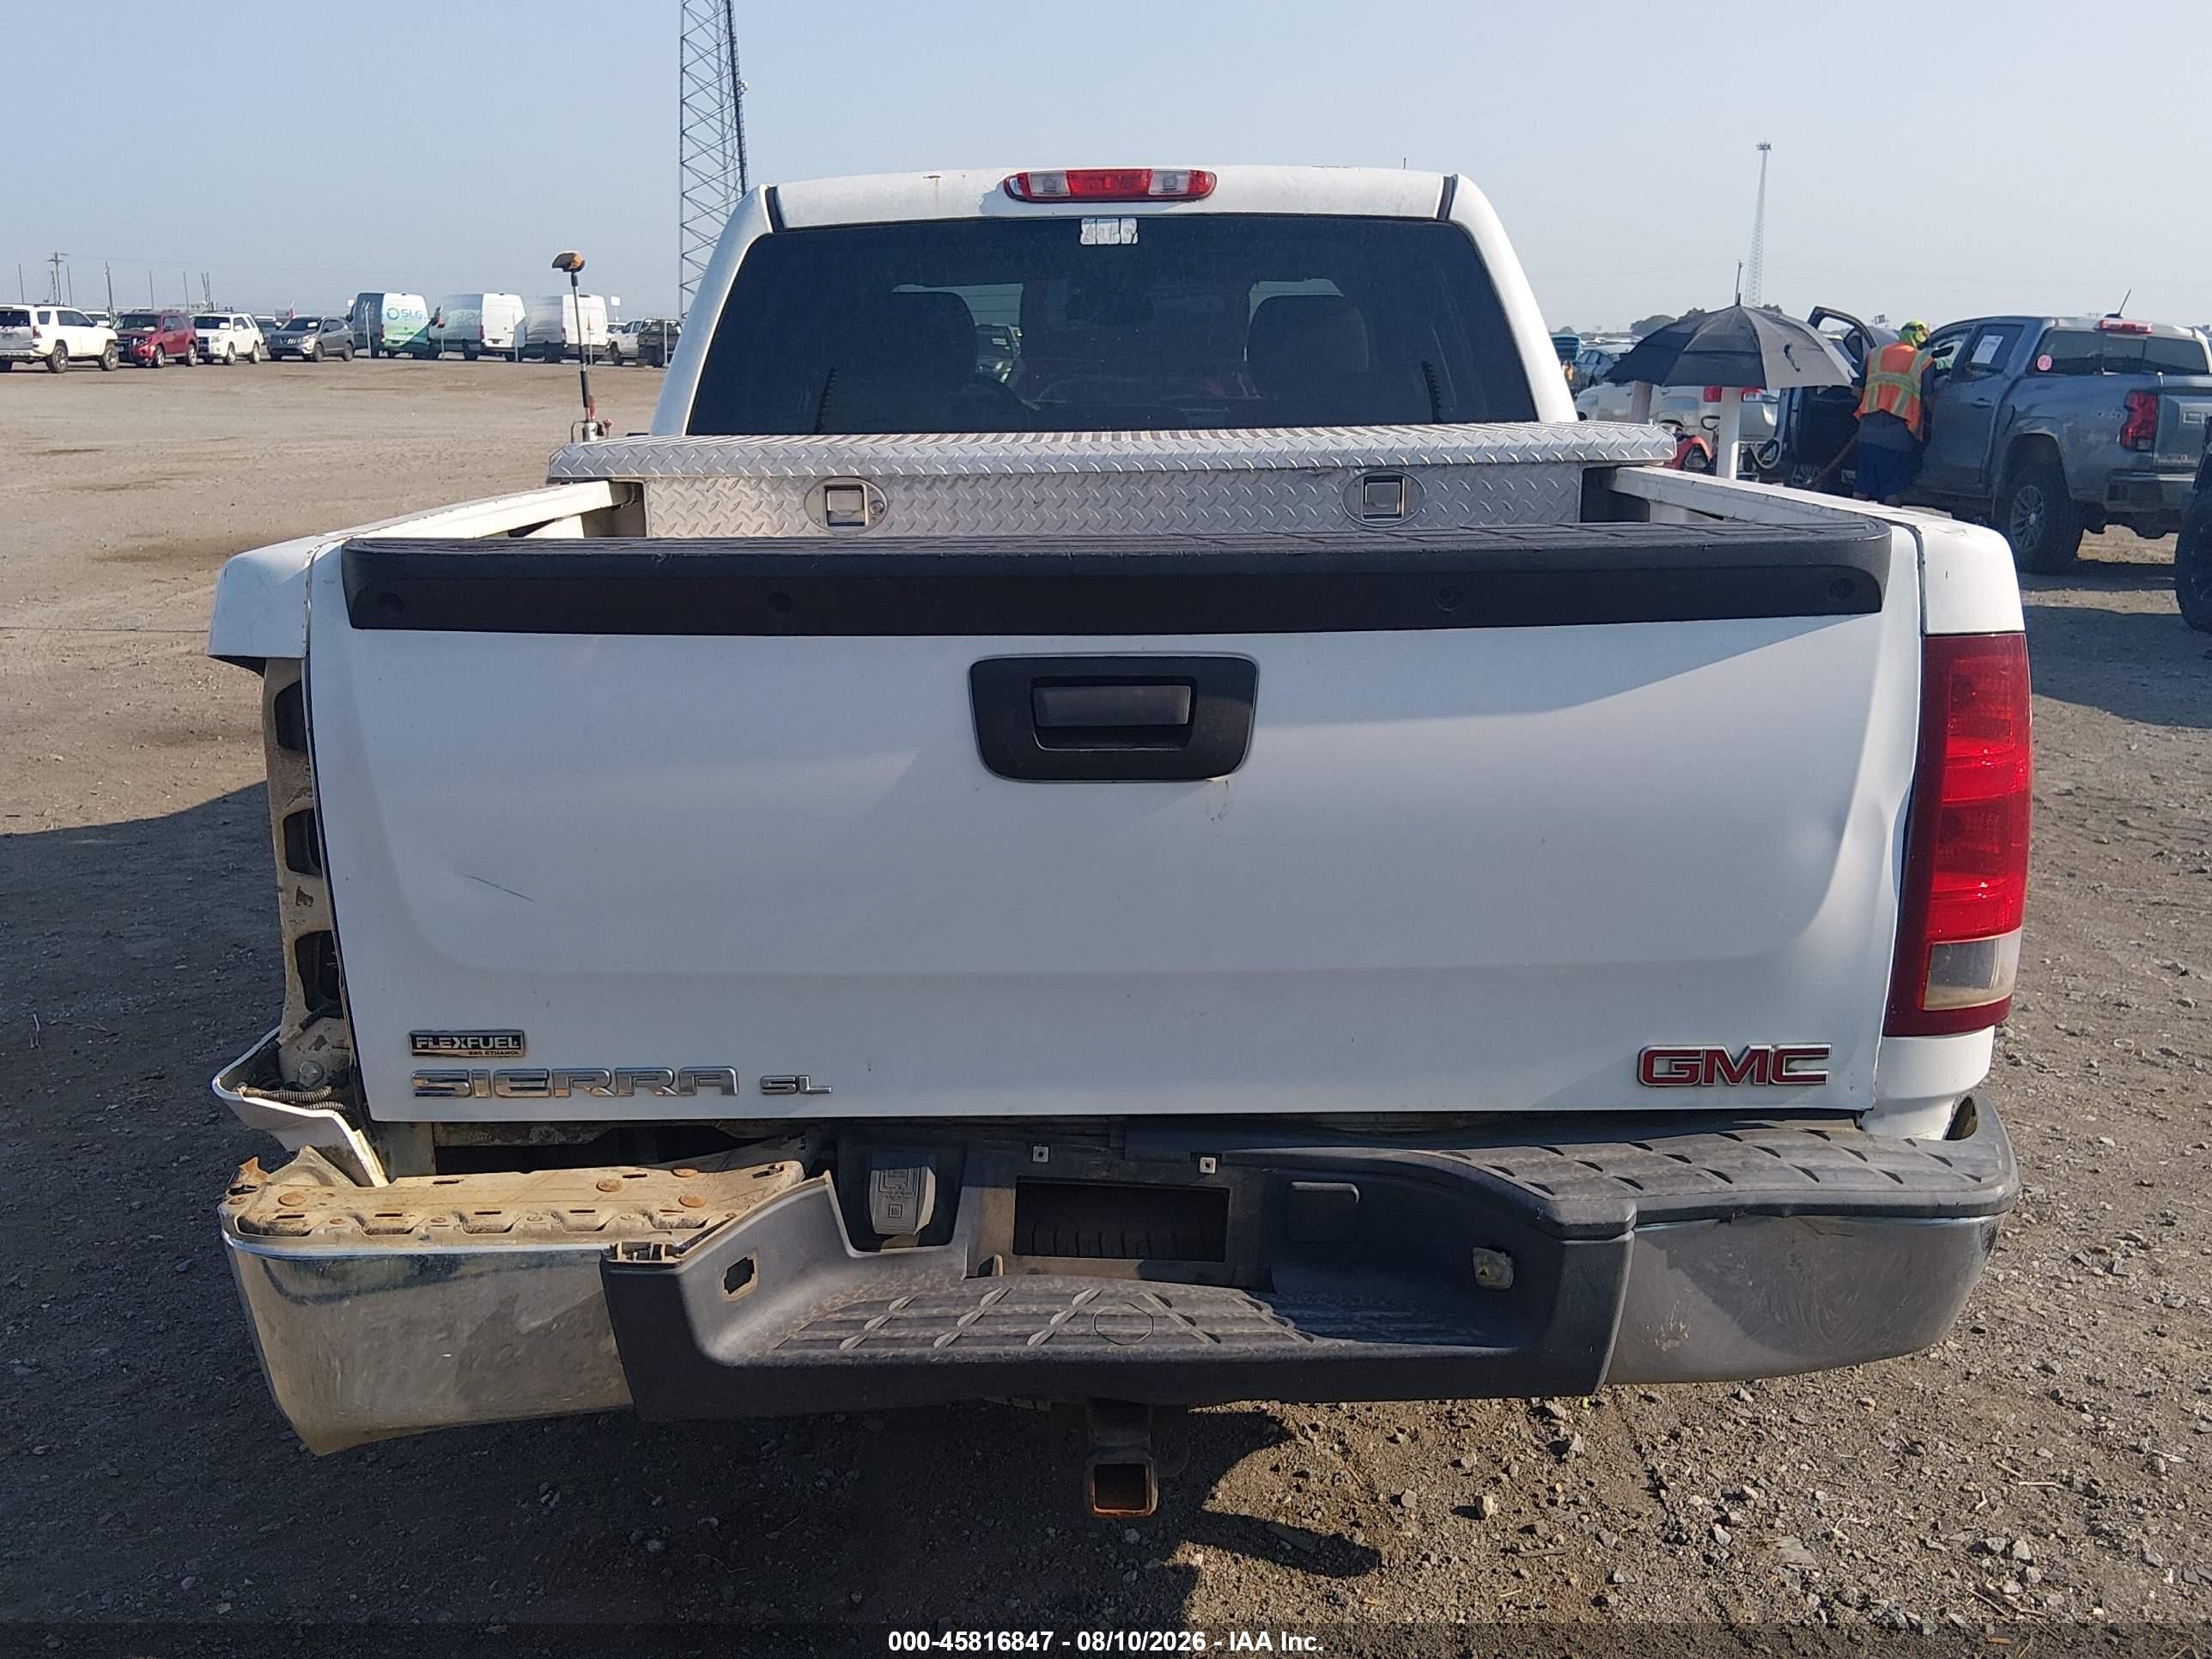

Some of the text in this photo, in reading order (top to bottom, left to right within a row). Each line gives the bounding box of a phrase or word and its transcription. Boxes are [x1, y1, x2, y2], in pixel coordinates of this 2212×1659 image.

[416, 1036, 520, 1049] FLEXFUEL
[1638, 1042, 1832, 1087] GMC
[411, 1066, 833, 1098] SIERRA SL
